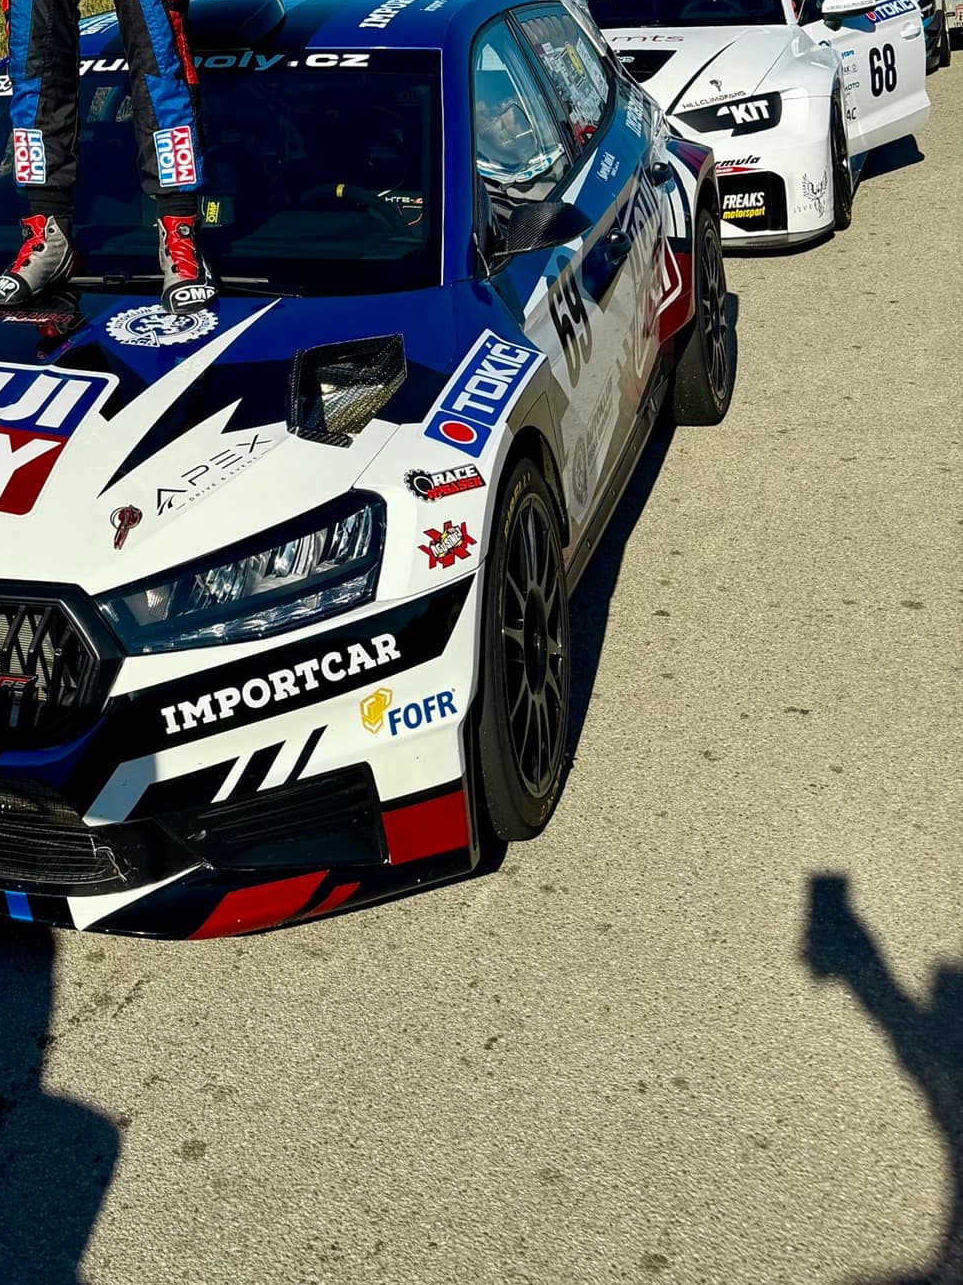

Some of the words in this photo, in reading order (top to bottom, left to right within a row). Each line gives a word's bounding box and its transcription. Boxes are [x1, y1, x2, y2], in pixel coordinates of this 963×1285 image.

[611, 34, 685, 43] mts
[868, 42, 898, 97] 68
[15, 132, 31, 181] MOLY
[27, 133, 44, 181] LIQUI
[156, 132, 176, 184] LIQUI
[173, 130, 194, 182] MOLY
[722, 191, 765, 210] FREAKS
[722, 206, 765, 220] motorsport
[174, 287, 218, 301] OMP
[452, 340, 531, 416] TOKIĆ
[157, 433, 273, 516] APEX
[431, 465, 479, 486] RACE
[160, 632, 402, 735] IMPORTCAR
[386, 689, 459, 737] FOFR
